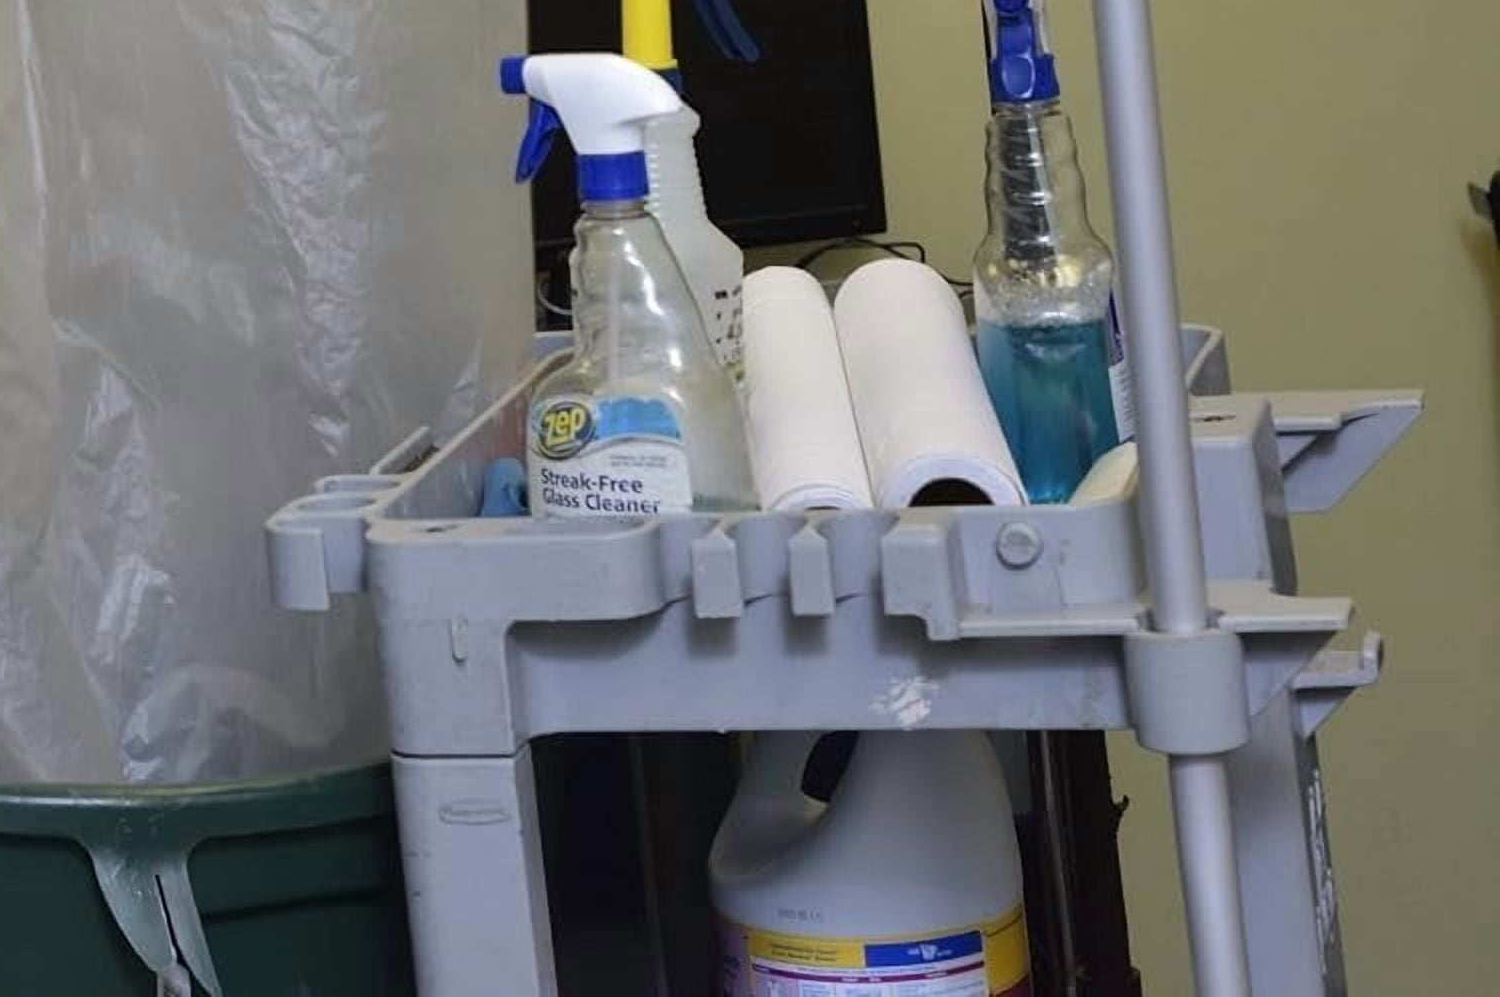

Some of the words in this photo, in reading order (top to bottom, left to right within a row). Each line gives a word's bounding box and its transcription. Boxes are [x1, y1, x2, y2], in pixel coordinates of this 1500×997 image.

[540, 467, 644, 494] Streak-Free
[542, 487, 581, 509] Glass
[584, 494, 661, 514] Cleaner
